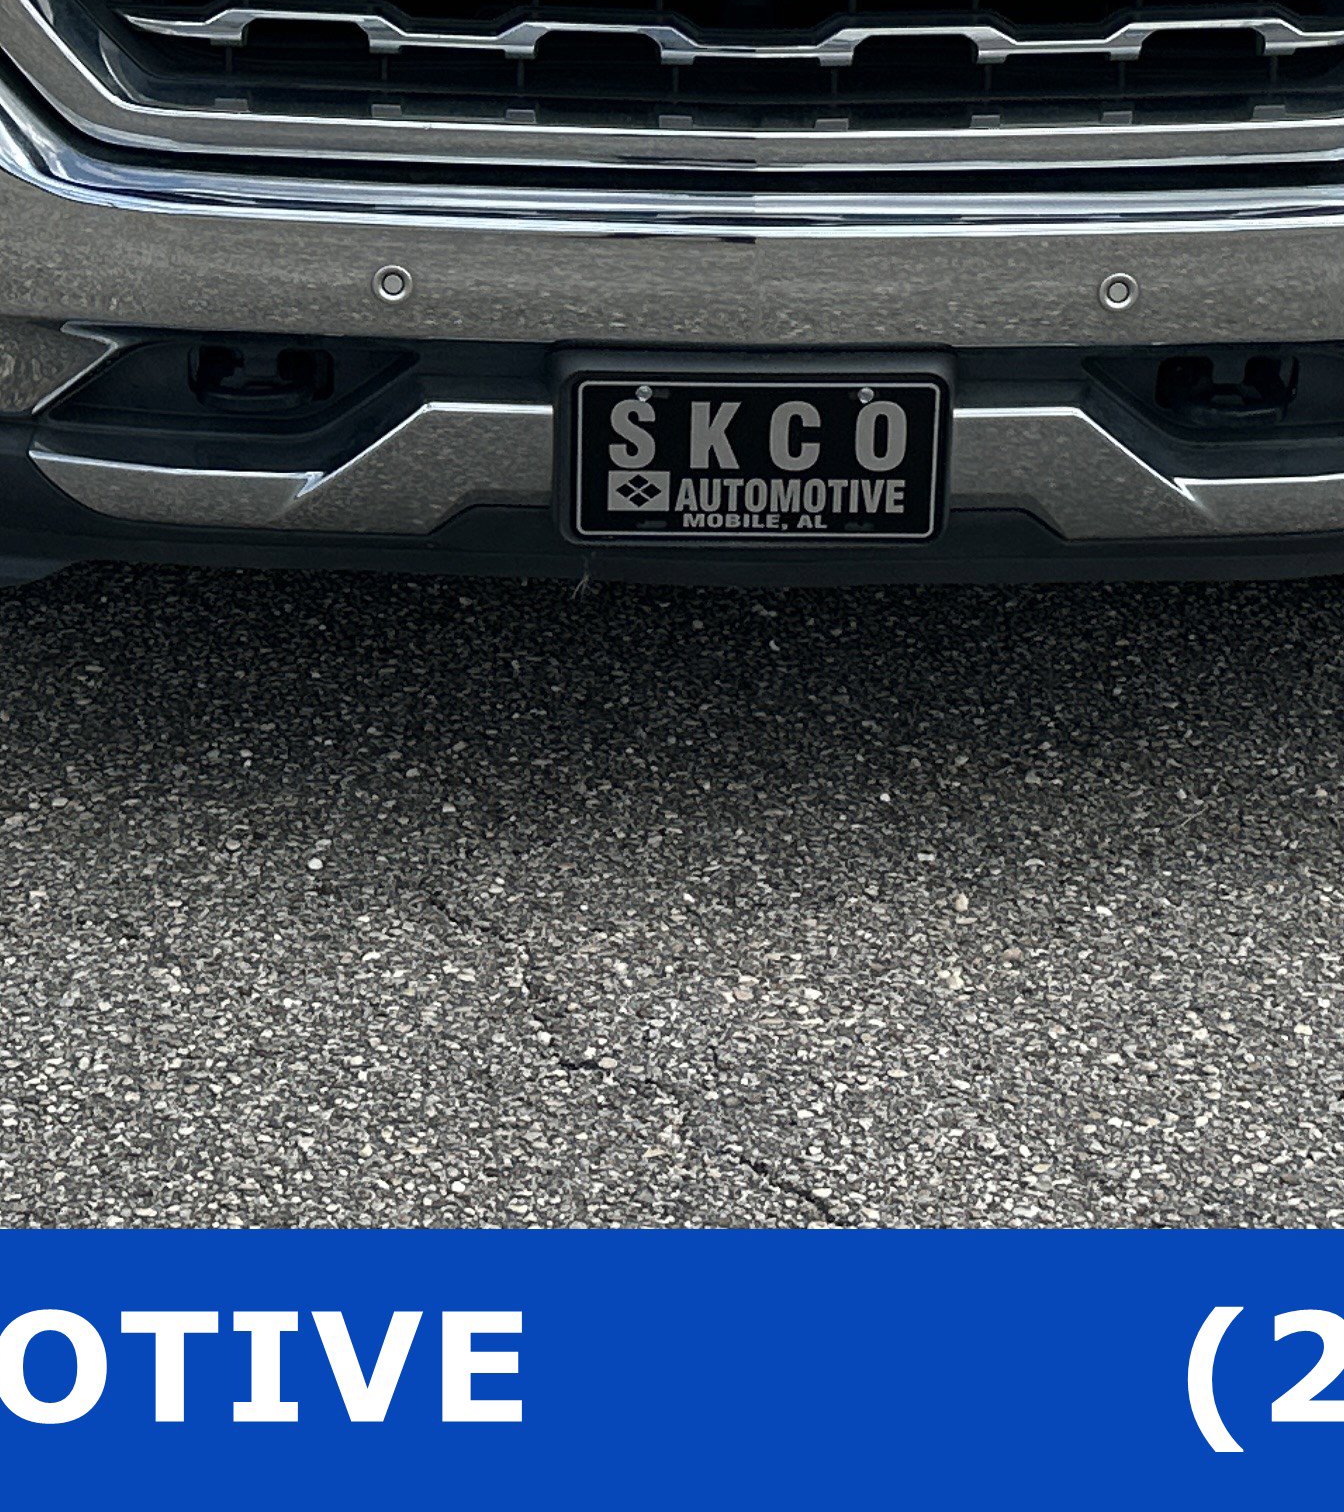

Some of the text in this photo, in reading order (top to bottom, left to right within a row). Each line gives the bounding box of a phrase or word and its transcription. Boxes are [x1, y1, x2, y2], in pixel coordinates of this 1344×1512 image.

[674, 477, 907, 514] AUTOMOTIVE
[682, 513, 829, 531] MOBILE, AL
